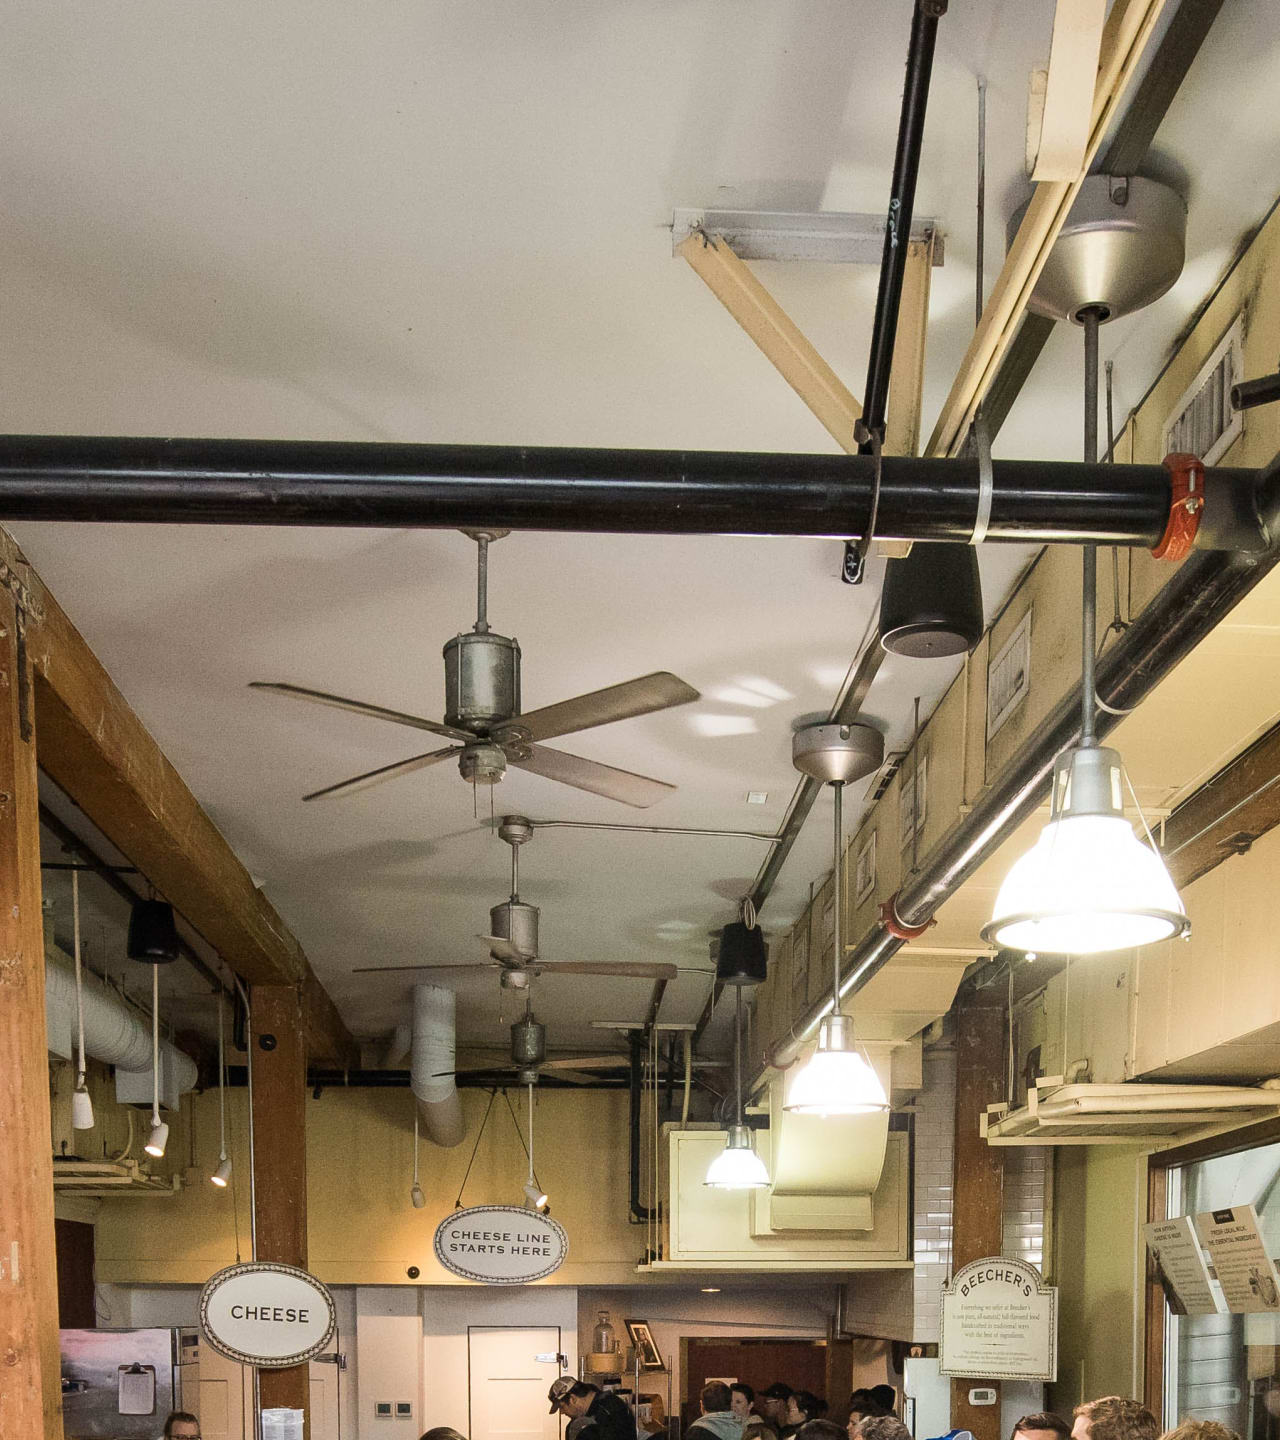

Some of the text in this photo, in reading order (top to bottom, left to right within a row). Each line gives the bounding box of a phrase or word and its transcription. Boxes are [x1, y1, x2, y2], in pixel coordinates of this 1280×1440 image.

[451, 1230, 551, 1243] CHEESE LINE
[449, 1243, 551, 1257] STARTS HERE
[961, 1269, 1031, 1296] BEECHER'S
[231, 1305, 309, 1323] CHEESE
